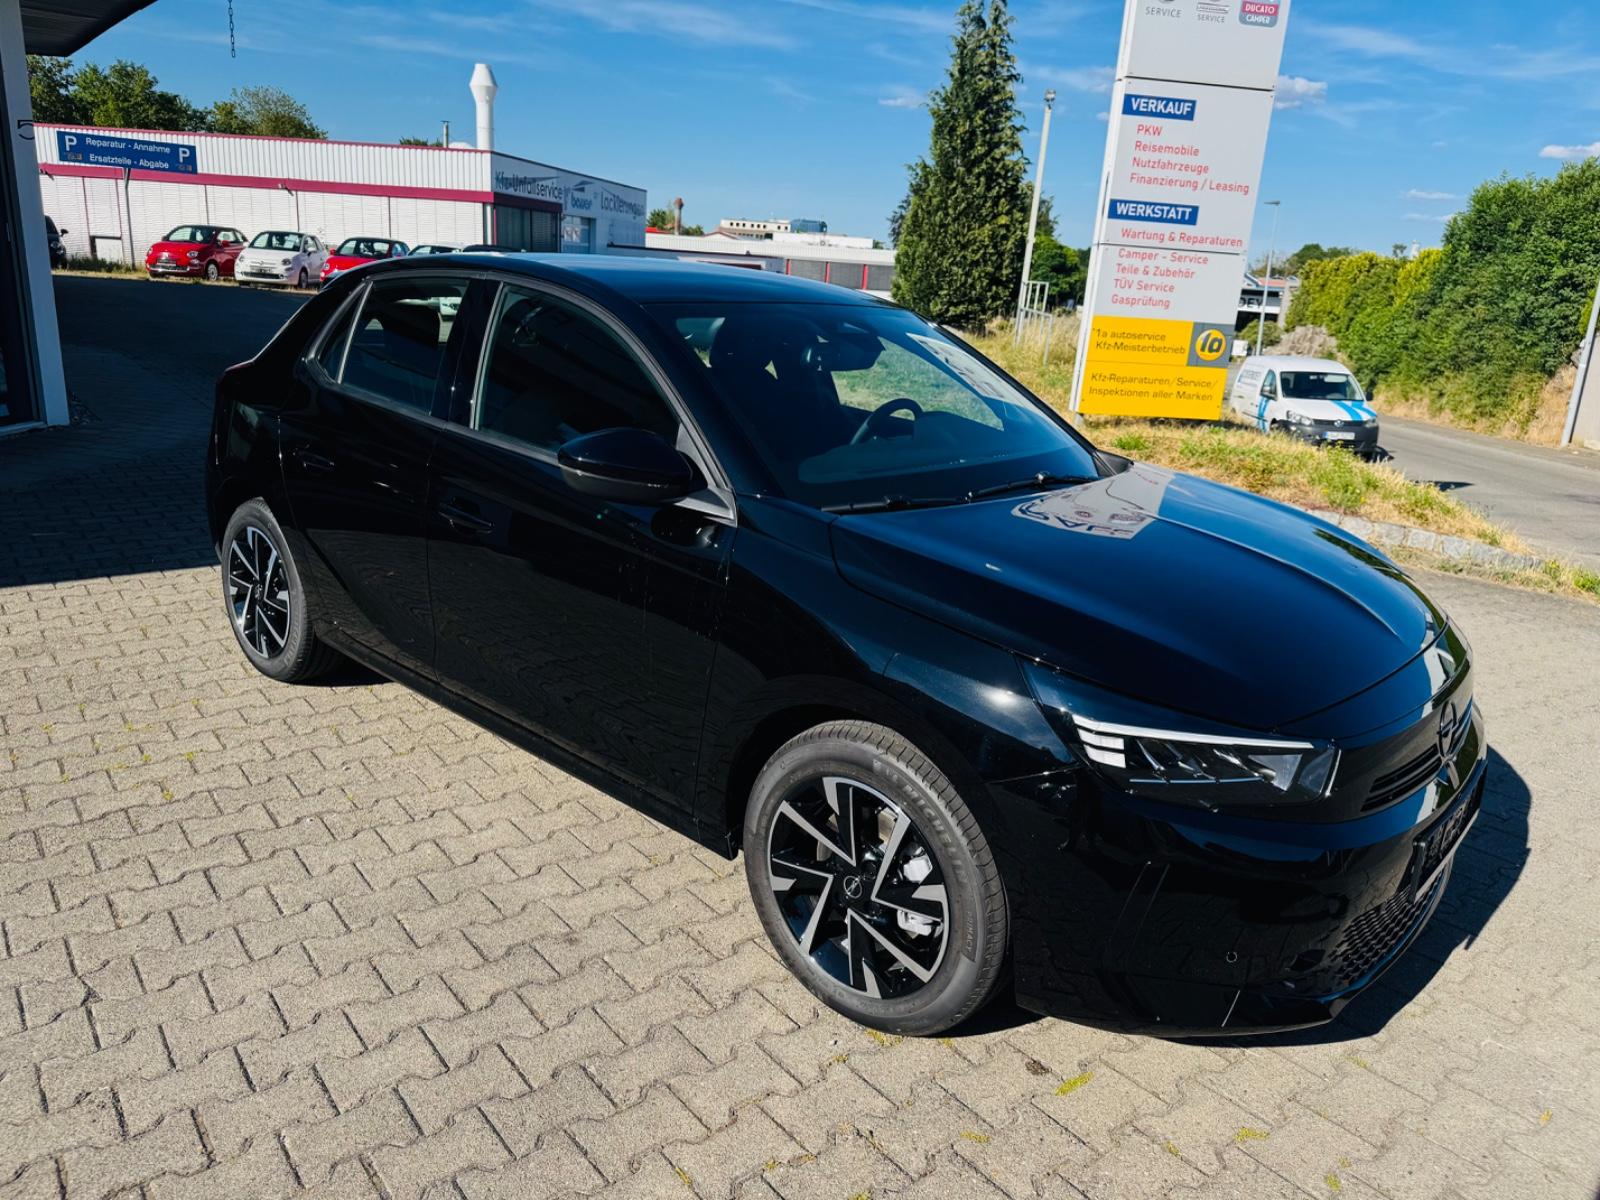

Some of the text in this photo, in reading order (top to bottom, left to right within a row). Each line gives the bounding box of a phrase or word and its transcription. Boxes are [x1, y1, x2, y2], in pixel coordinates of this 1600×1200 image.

[1145, 6, 1182, 18] SERVICE
[1245, 3, 1275, 14] DUCATO
[1197, 14, 1225, 23] SERVICE
[1246, 14, 1270, 24] CAMPER
[1131, 97, 1193, 116] VERKAUF
[1136, 124, 1163, 137] PKW
[64, 135, 77, 151] P
[85, 137, 126, 149] Reparatur
[133, 142, 171, 153] Annahme
[1134, 140, 1200, 157] Reisemobile
[89, 153, 132, 166] Ersatzteile
[139, 157, 169, 169] Abgabe
[178, 147, 190, 163] P
[1132, 157, 1210, 176] Nutzfahrzeuge
[1129, 173, 1199, 192] Finanzierung
[1209, 179, 1250, 196] Leasing
[1116, 202, 1193, 221] WERKSTATT
[1121, 228, 1243, 248] Wartung & Reparaturen
[1118, 248, 1160, 263] Camper
[1171, 252, 1209, 265] Service
[1116, 263, 1196, 280] Teile & Zubehör
[1113, 277, 1175, 293] TÜV Service
[1111, 294, 1170, 310] Gasprüfung
[1097, 328, 1166, 341] 1a autoservice
[1096, 341, 1186, 355] Kfz-Meisterbetrieb
[1200, 333, 1223, 353] 1a
[1089, 387, 1213, 401] Inspektionen aller Marken
